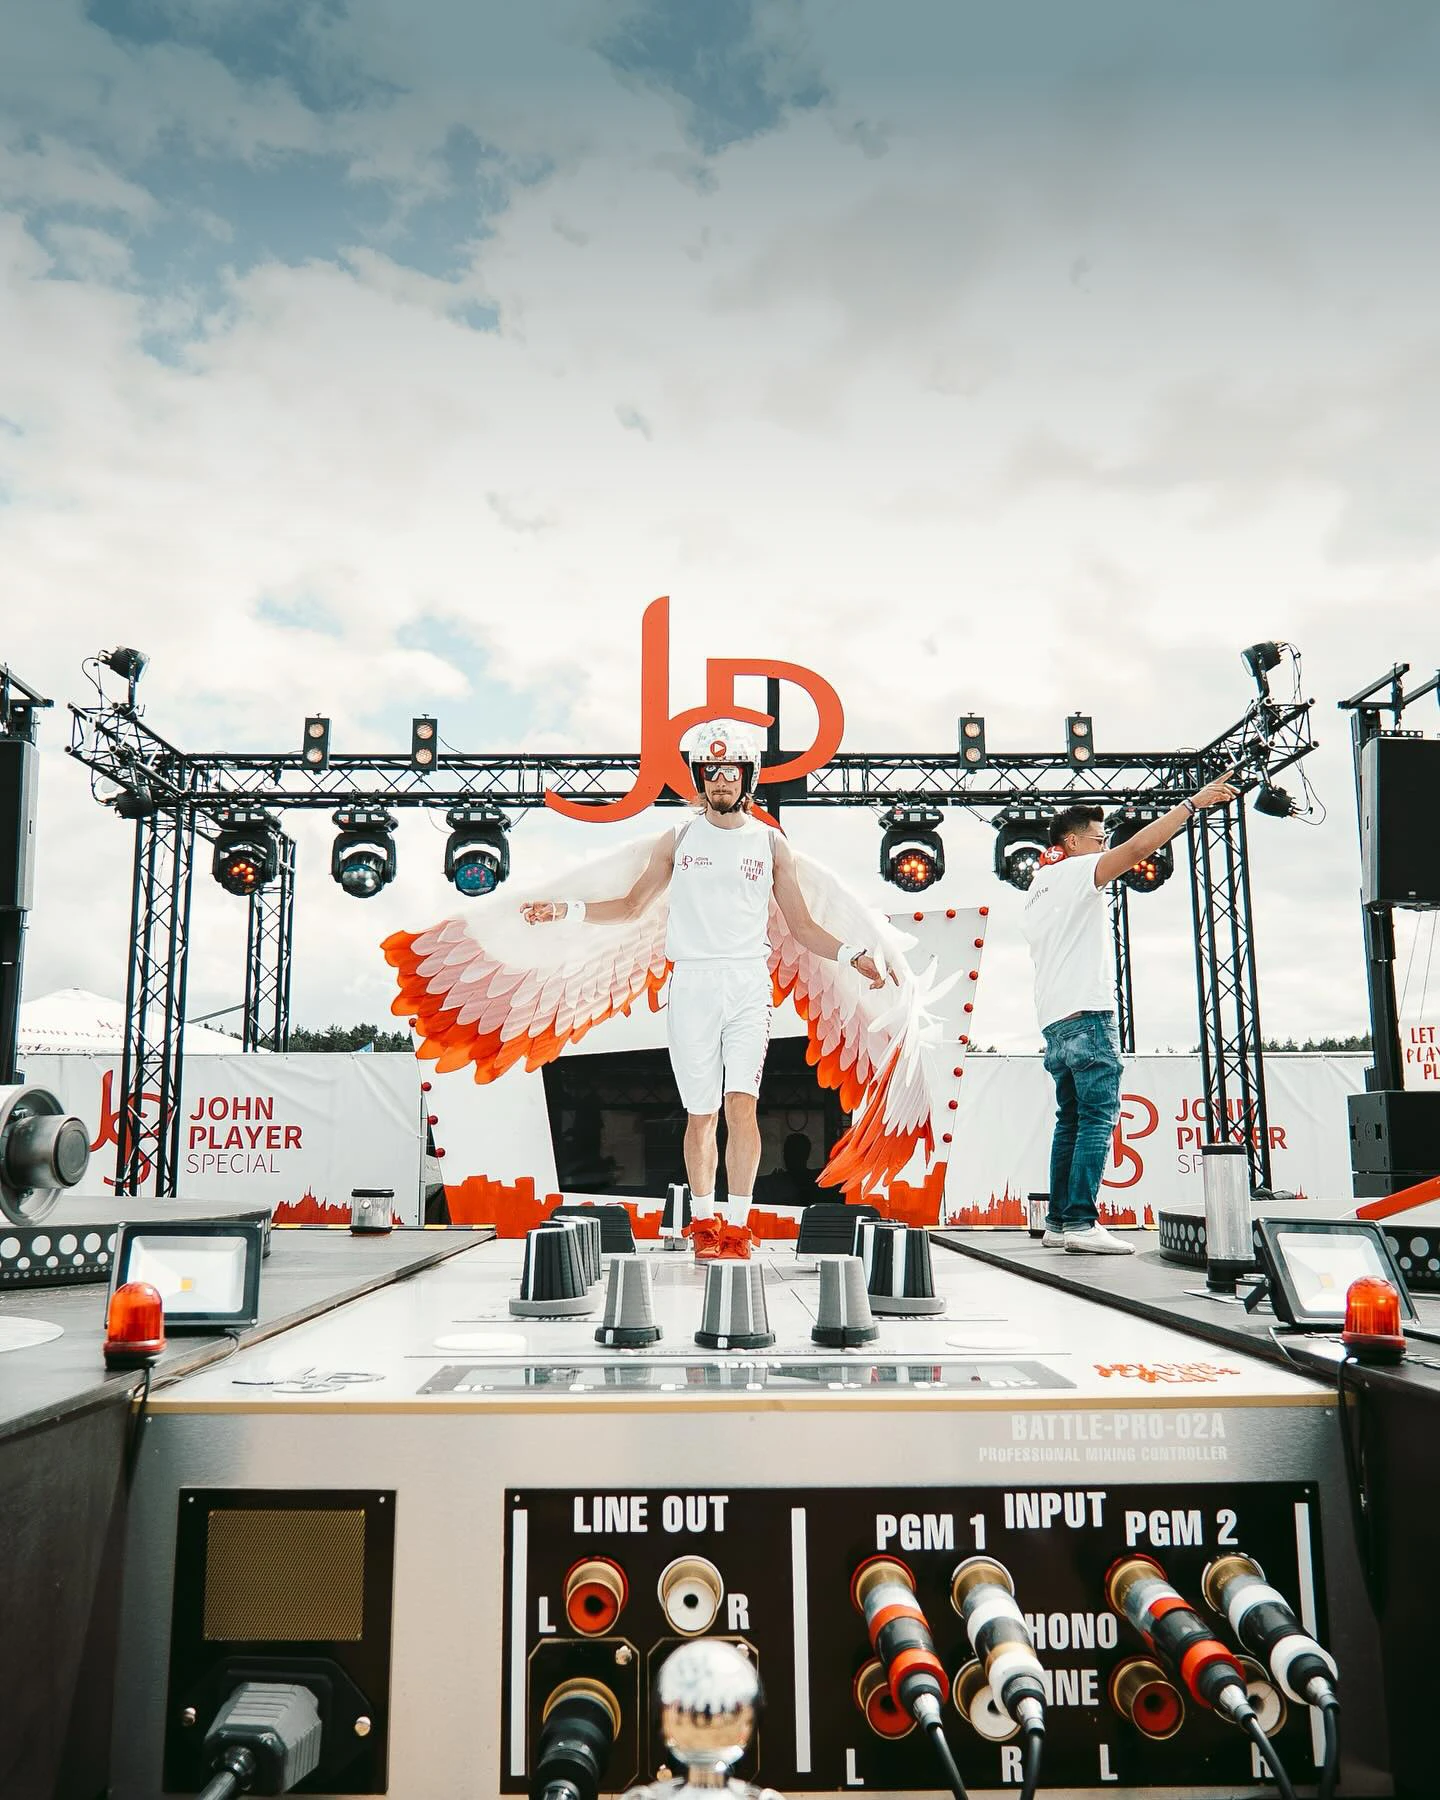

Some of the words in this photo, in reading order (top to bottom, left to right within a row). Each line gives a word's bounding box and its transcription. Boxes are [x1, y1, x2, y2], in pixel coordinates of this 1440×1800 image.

[1410, 1027, 1435, 1044] LET
[189, 1097, 273, 1121] JOHN
[189, 1126, 303, 1150] PLAYER
[186, 1153, 281, 1174] SPECIAL
[979, 1447, 1080, 1462] PROFESSIONAL
[1085, 1447, 1136, 1462] MIXING
[1141, 1446, 1228, 1461] CONTROLLER
[573, 1496, 648, 1533] LINE
[662, 1495, 729, 1533] OUT
[1004, 1491, 1107, 1529] INPUT
[1125, 1510, 1203, 1546] PGM
[1216, 1509, 1239, 1545] 2
[876, 1514, 954, 1550] PGM
[969, 1513, 986, 1549] 1
[538, 1596, 557, 1633] L
[727, 1593, 750, 1630] R
[1024, 1612, 1118, 1649] HONO
[1043, 1669, 1099, 1706] INE
[846, 1748, 864, 1785] L
[1001, 1746, 1024, 1782] R
[1100, 1744, 1118, 1780] L
